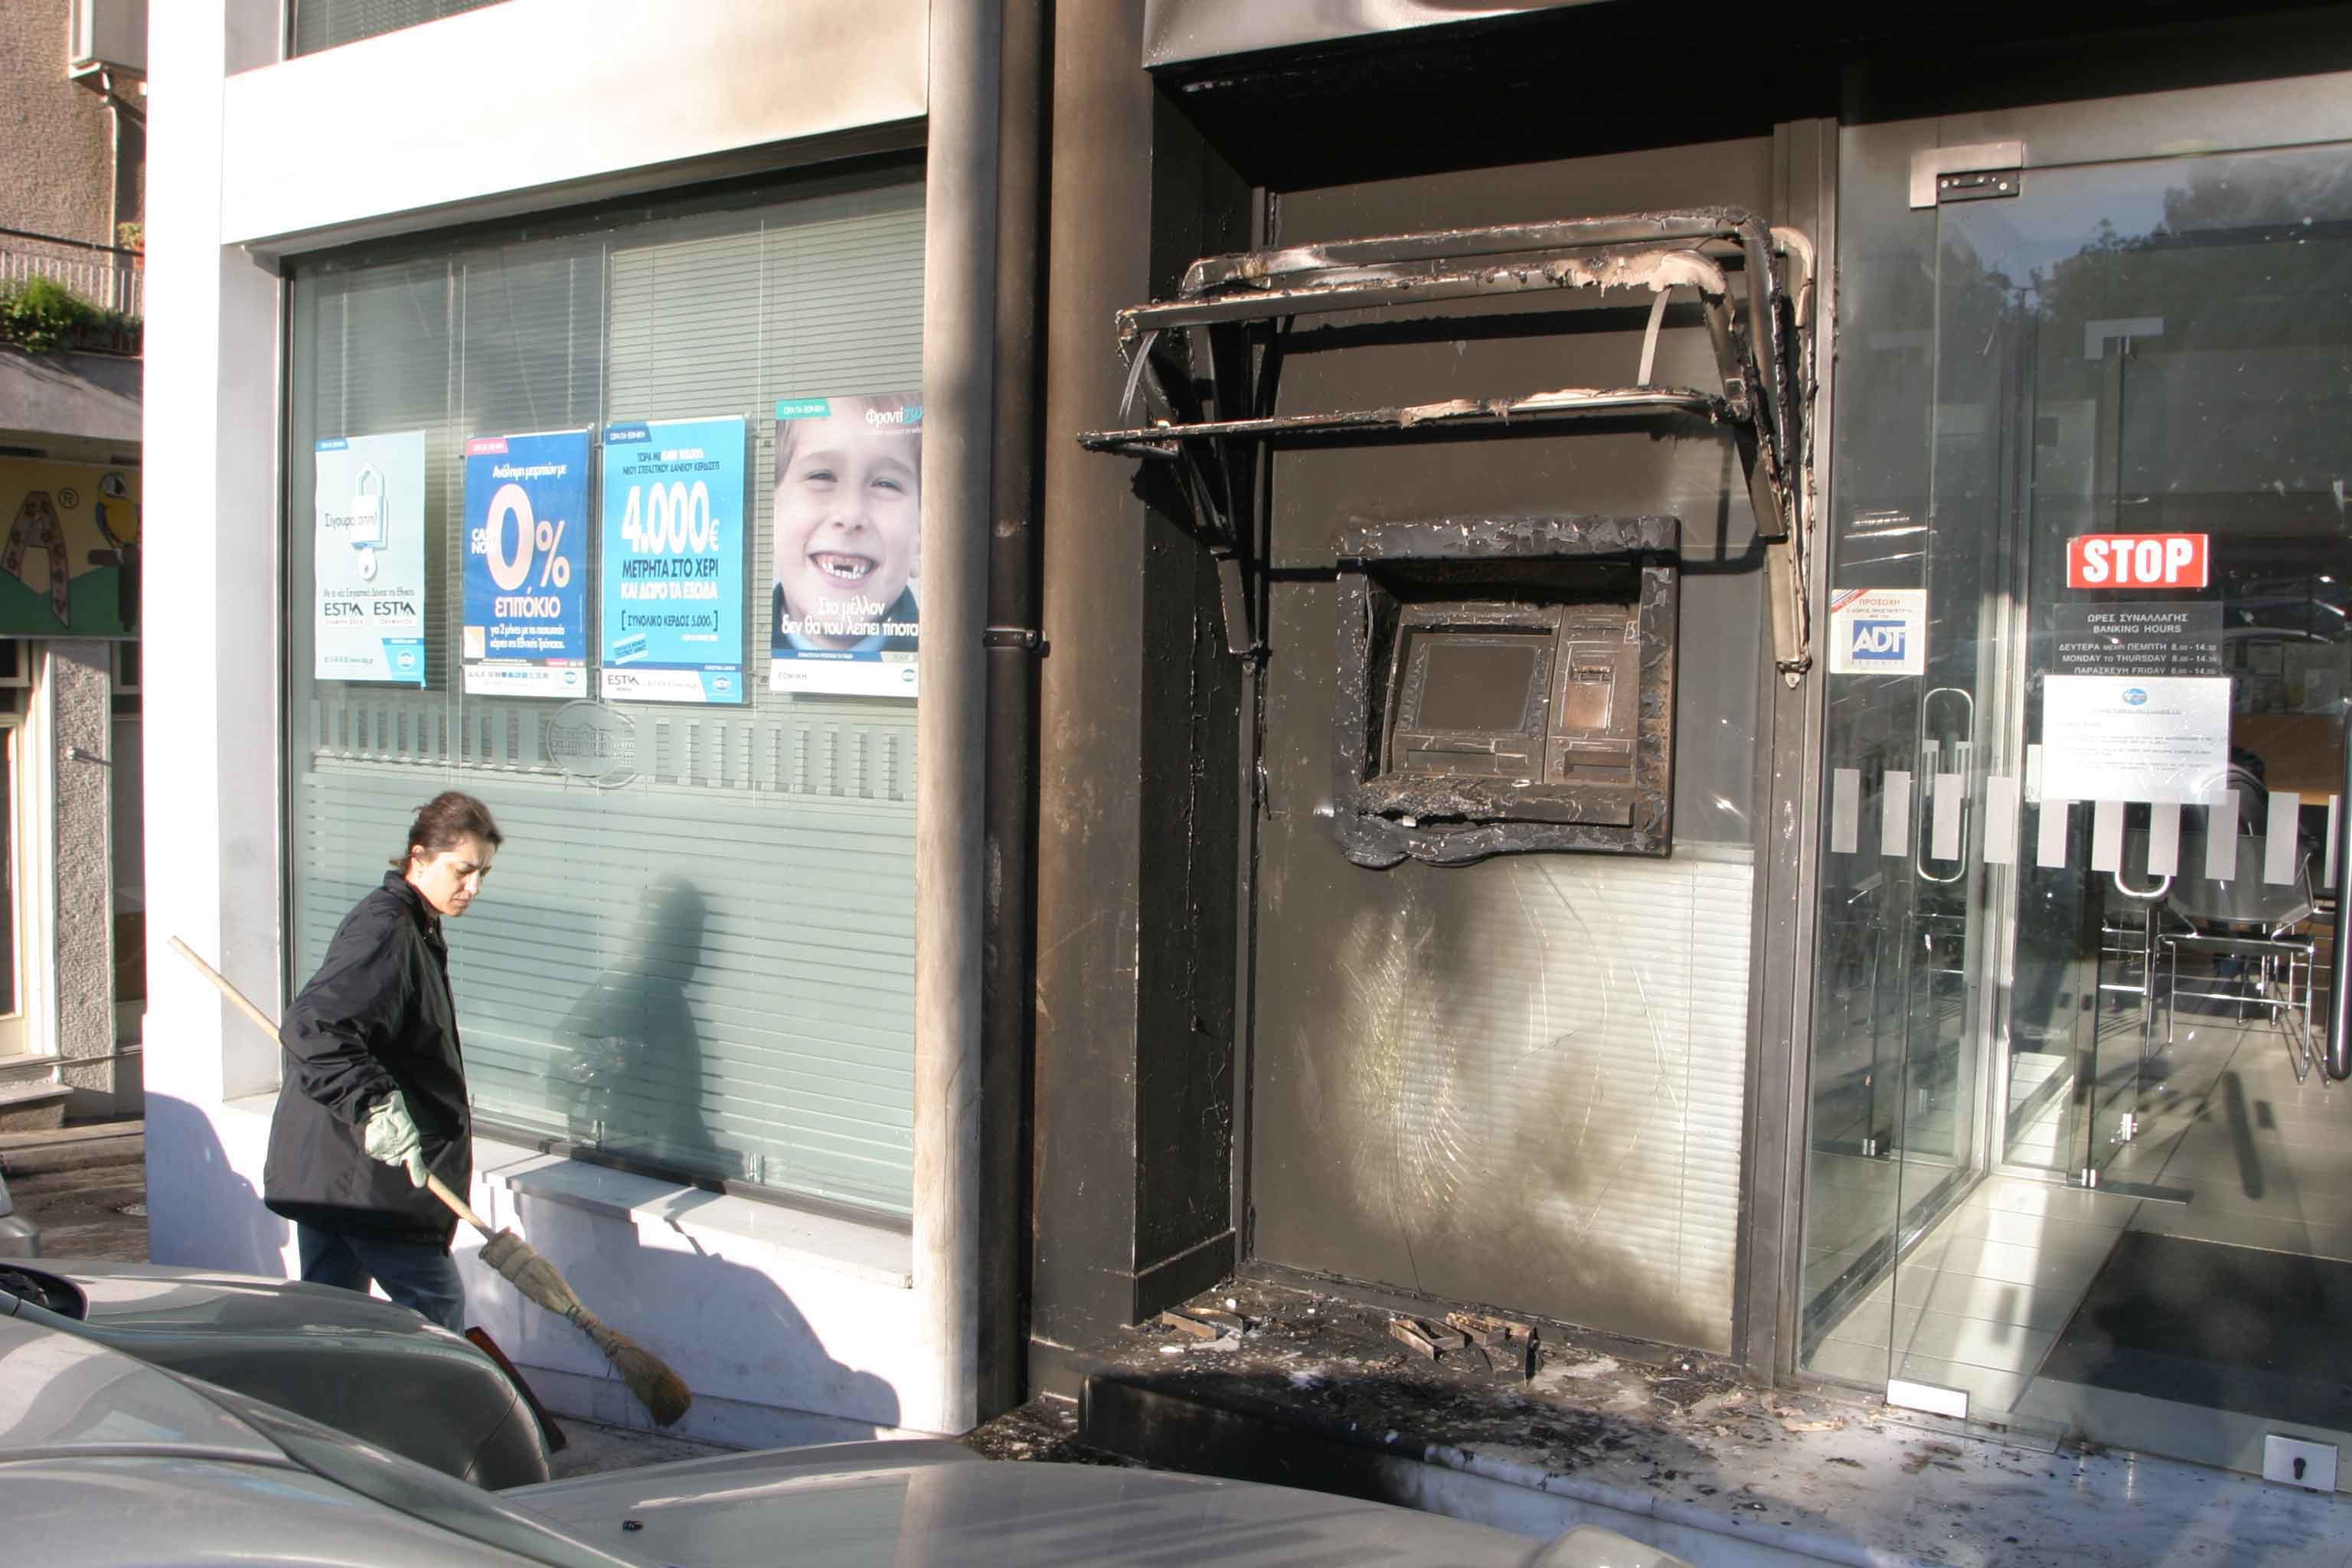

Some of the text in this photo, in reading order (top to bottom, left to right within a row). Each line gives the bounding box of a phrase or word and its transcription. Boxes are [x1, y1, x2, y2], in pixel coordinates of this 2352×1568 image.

[622, 558, 718, 578] ΜΕΤΡΗΤΑ ΣΤΟ ΧΕΡΙ
[2082, 538, 2193, 583] STOP
[842, 595, 886, 621] μέλλον
[2087, 613, 2188, 622] ΩΡΕΣ ΣΥΝΑΛΛΑΓΗΣ
[628, 615, 662, 627] ΣΥΝΟΛΙΚΟ
[664, 615, 689, 627] ΚΕΡΔΟΣ
[782, 614, 802, 634] δεν
[805, 615, 821, 635] θα
[824, 621, 843, 635] του
[846, 615, 880, 636] λείπει
[2093, 625, 2181, 634] BANKING HOURS
[1850, 626, 1906, 652] ADT
